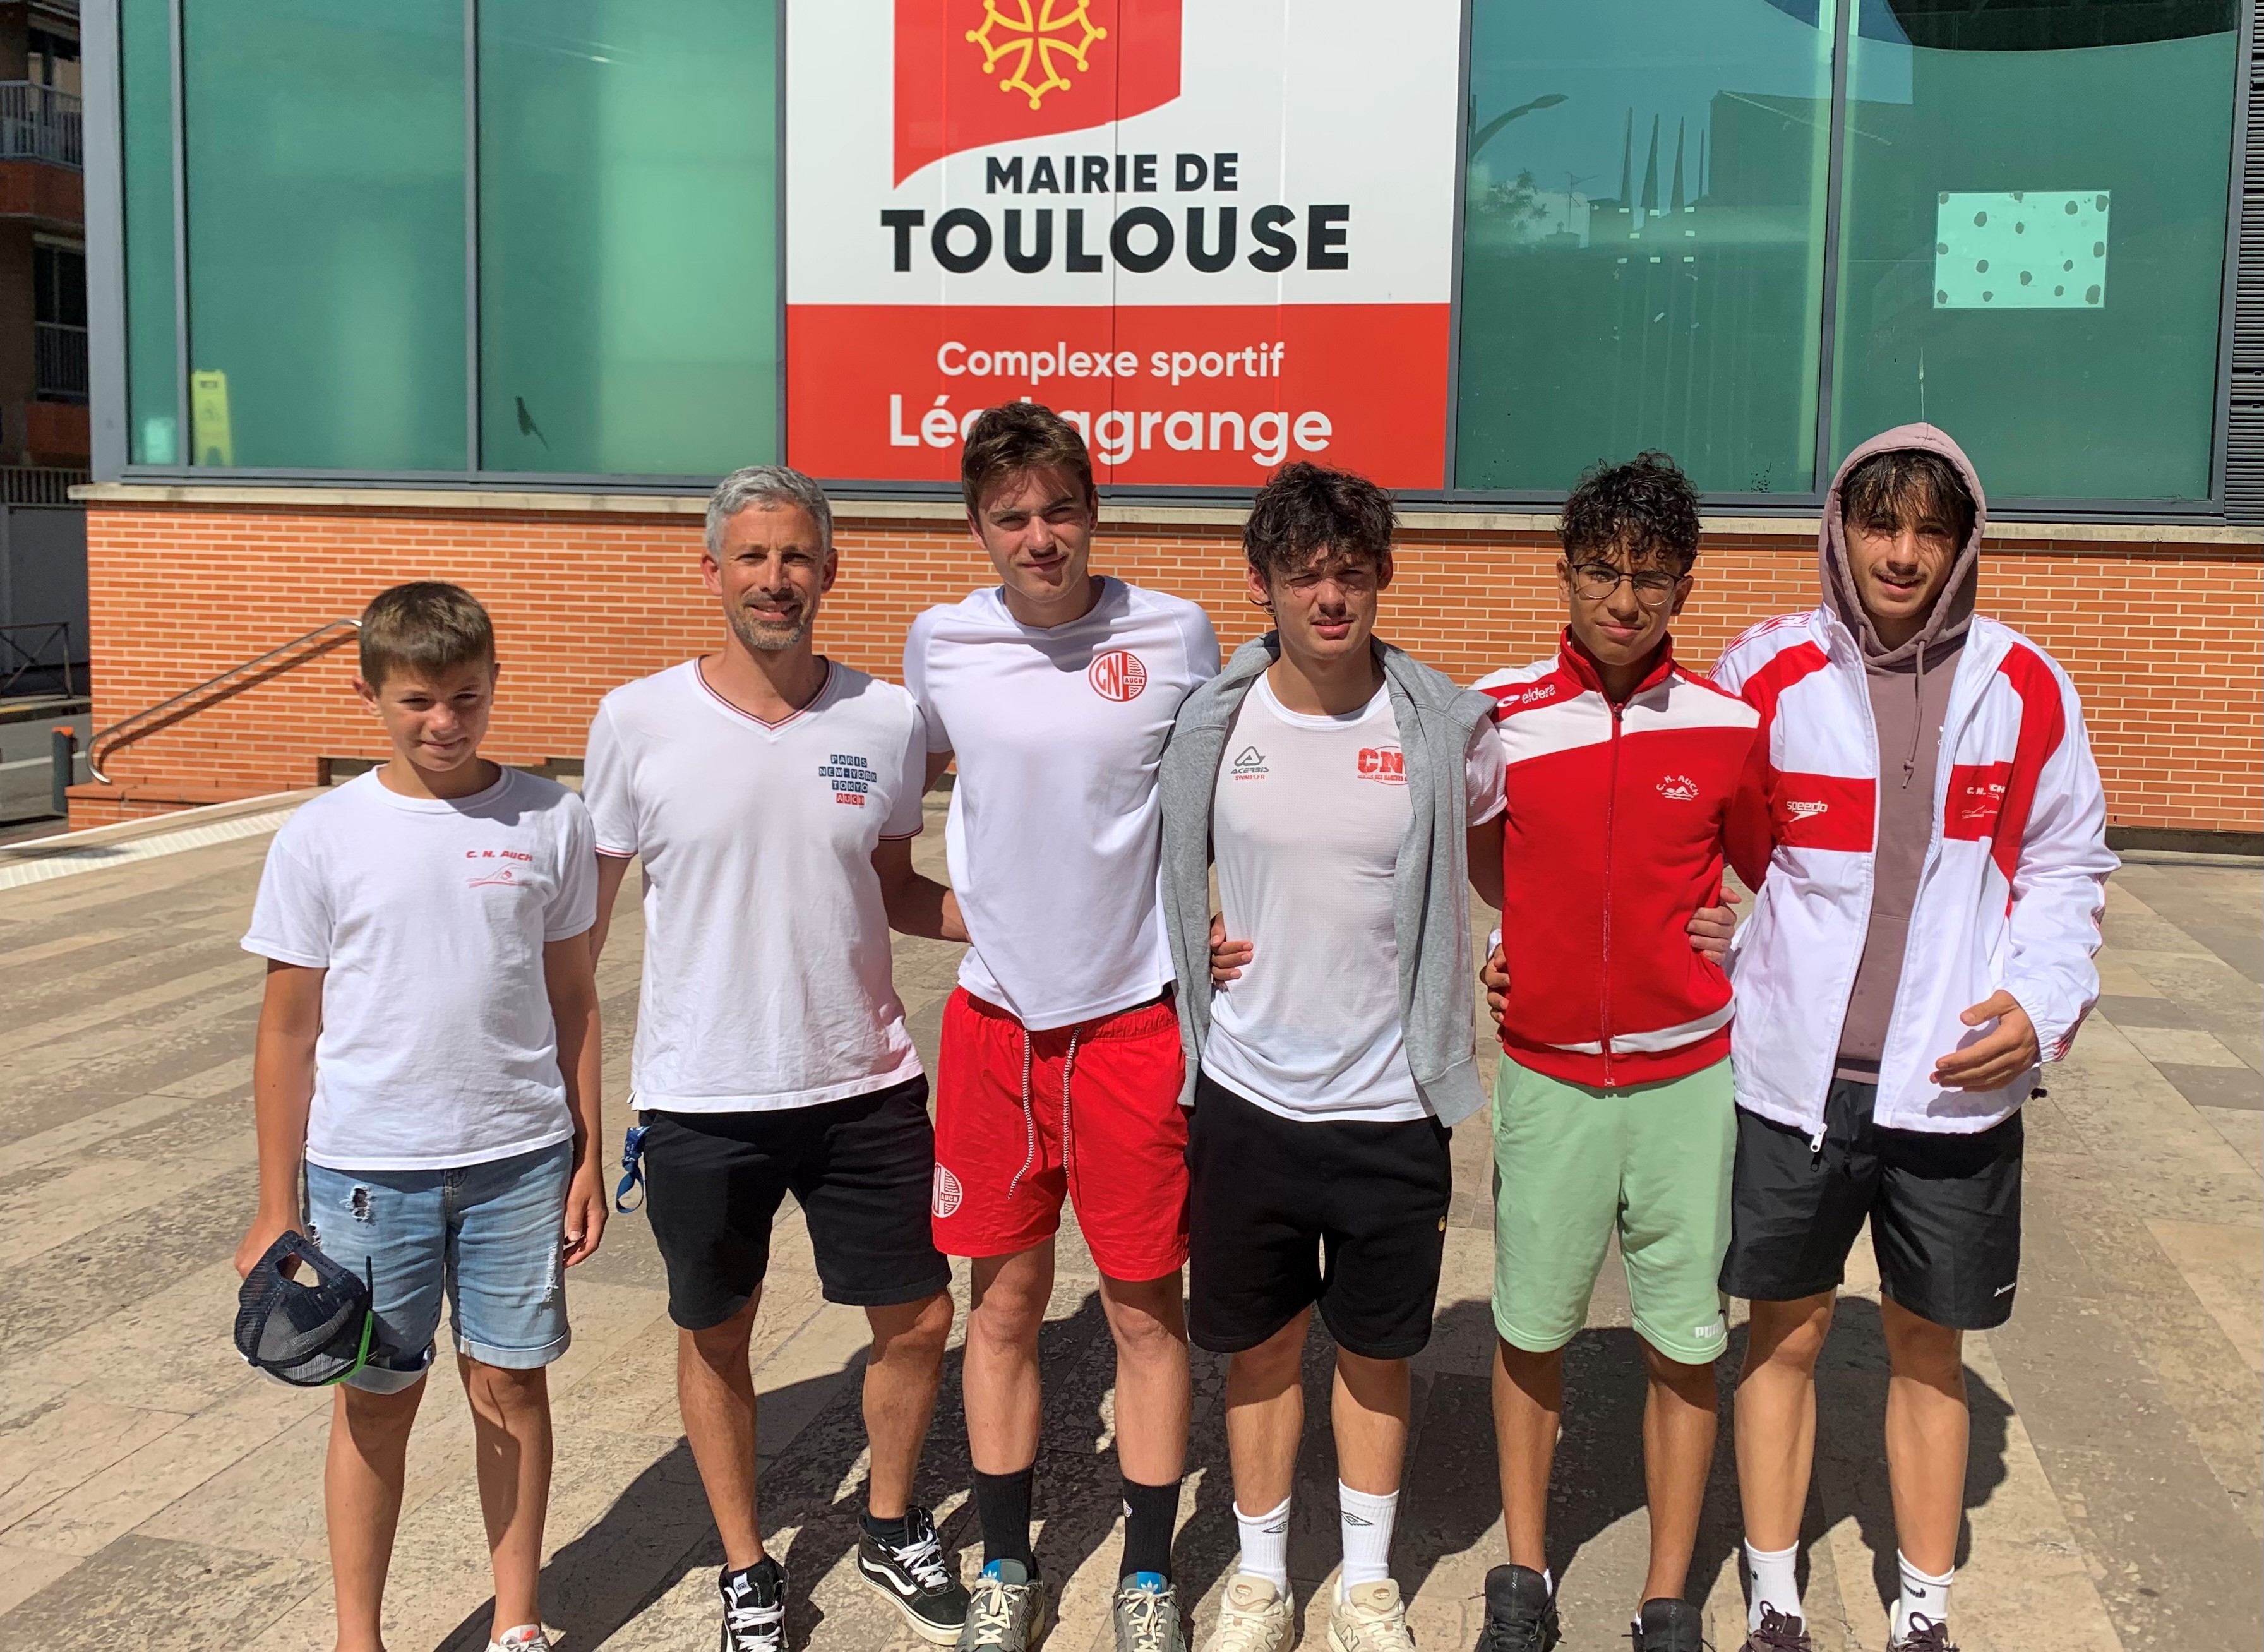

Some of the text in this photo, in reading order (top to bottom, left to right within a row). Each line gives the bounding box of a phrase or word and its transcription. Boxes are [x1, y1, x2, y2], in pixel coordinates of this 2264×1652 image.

[986, 153, 1238, 194] MAIRIE DE
[880, 204, 1350, 274] TOULOUSE
[937, 341, 1285, 386] Complexe sportif
[1020, 396, 1333, 466] agrange
[830, 754, 868, 768] PARIS
[819, 766, 877, 783] NEW-YORK
[832, 779, 868, 794] TOKYO
[1677, 775, 1700, 796] AUCH
[836, 793, 865, 806] AUCH
[1786, 800, 1828, 813] speedo
[500, 850, 533, 861] AUCH
[940, 1193, 959, 1202] AUCH
